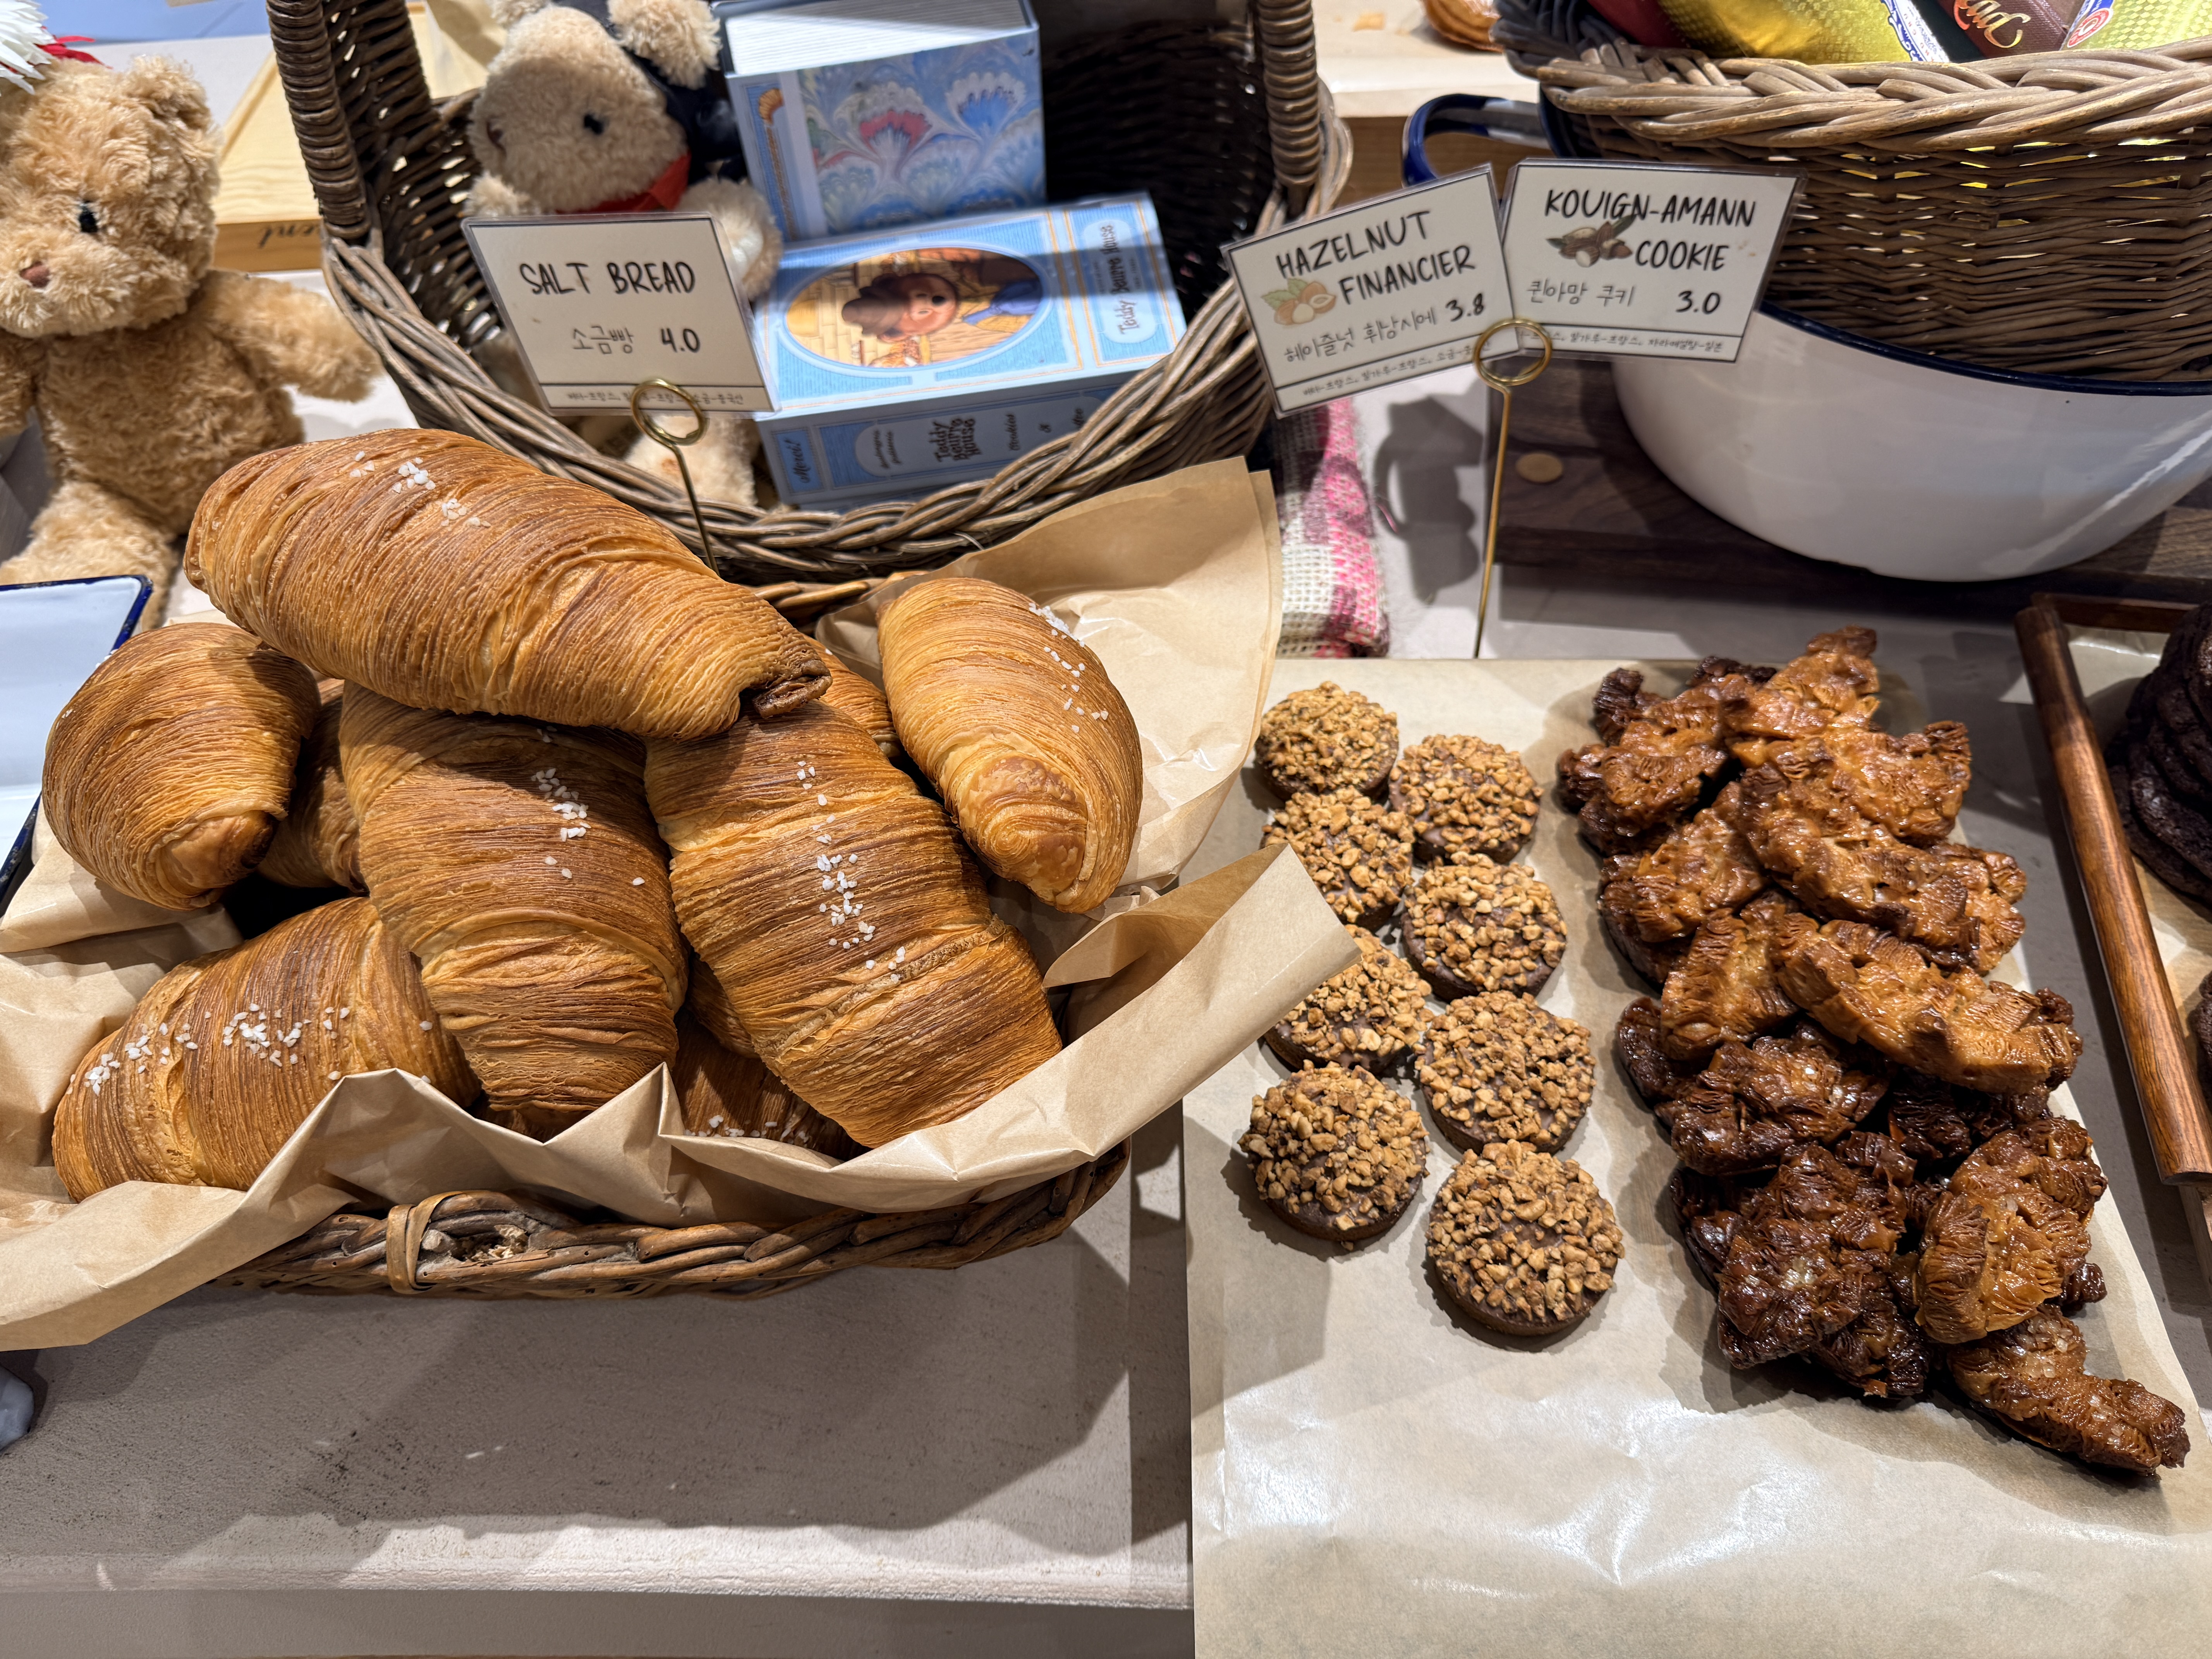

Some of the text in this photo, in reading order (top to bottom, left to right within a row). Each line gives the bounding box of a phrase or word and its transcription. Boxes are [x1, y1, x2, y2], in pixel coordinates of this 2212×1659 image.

[1544, 189, 1756, 227] KOUIGN-AMANN
[1099, 224, 1120, 254] House
[1276, 211, 1430, 279] HAZELNUT
[1635, 240, 1729, 271] COOKIE
[519, 261, 696, 295] SALT BREAD
[1338, 245, 1475, 305] FINANCIER
[1113, 300, 1140, 334] Teddy
[1596, 285, 1636, 307] 쿠키
[1676, 290, 1721, 315] 3.0
[572, 325, 701, 355] 소금빵 4.0
[1284, 292, 1486, 362] 헤이즐넛 휘낭시에 3.8
[928, 419, 951, 462] Teddy
[961, 418, 982, 456] House
[784, 436, 811, 483] Merci!
